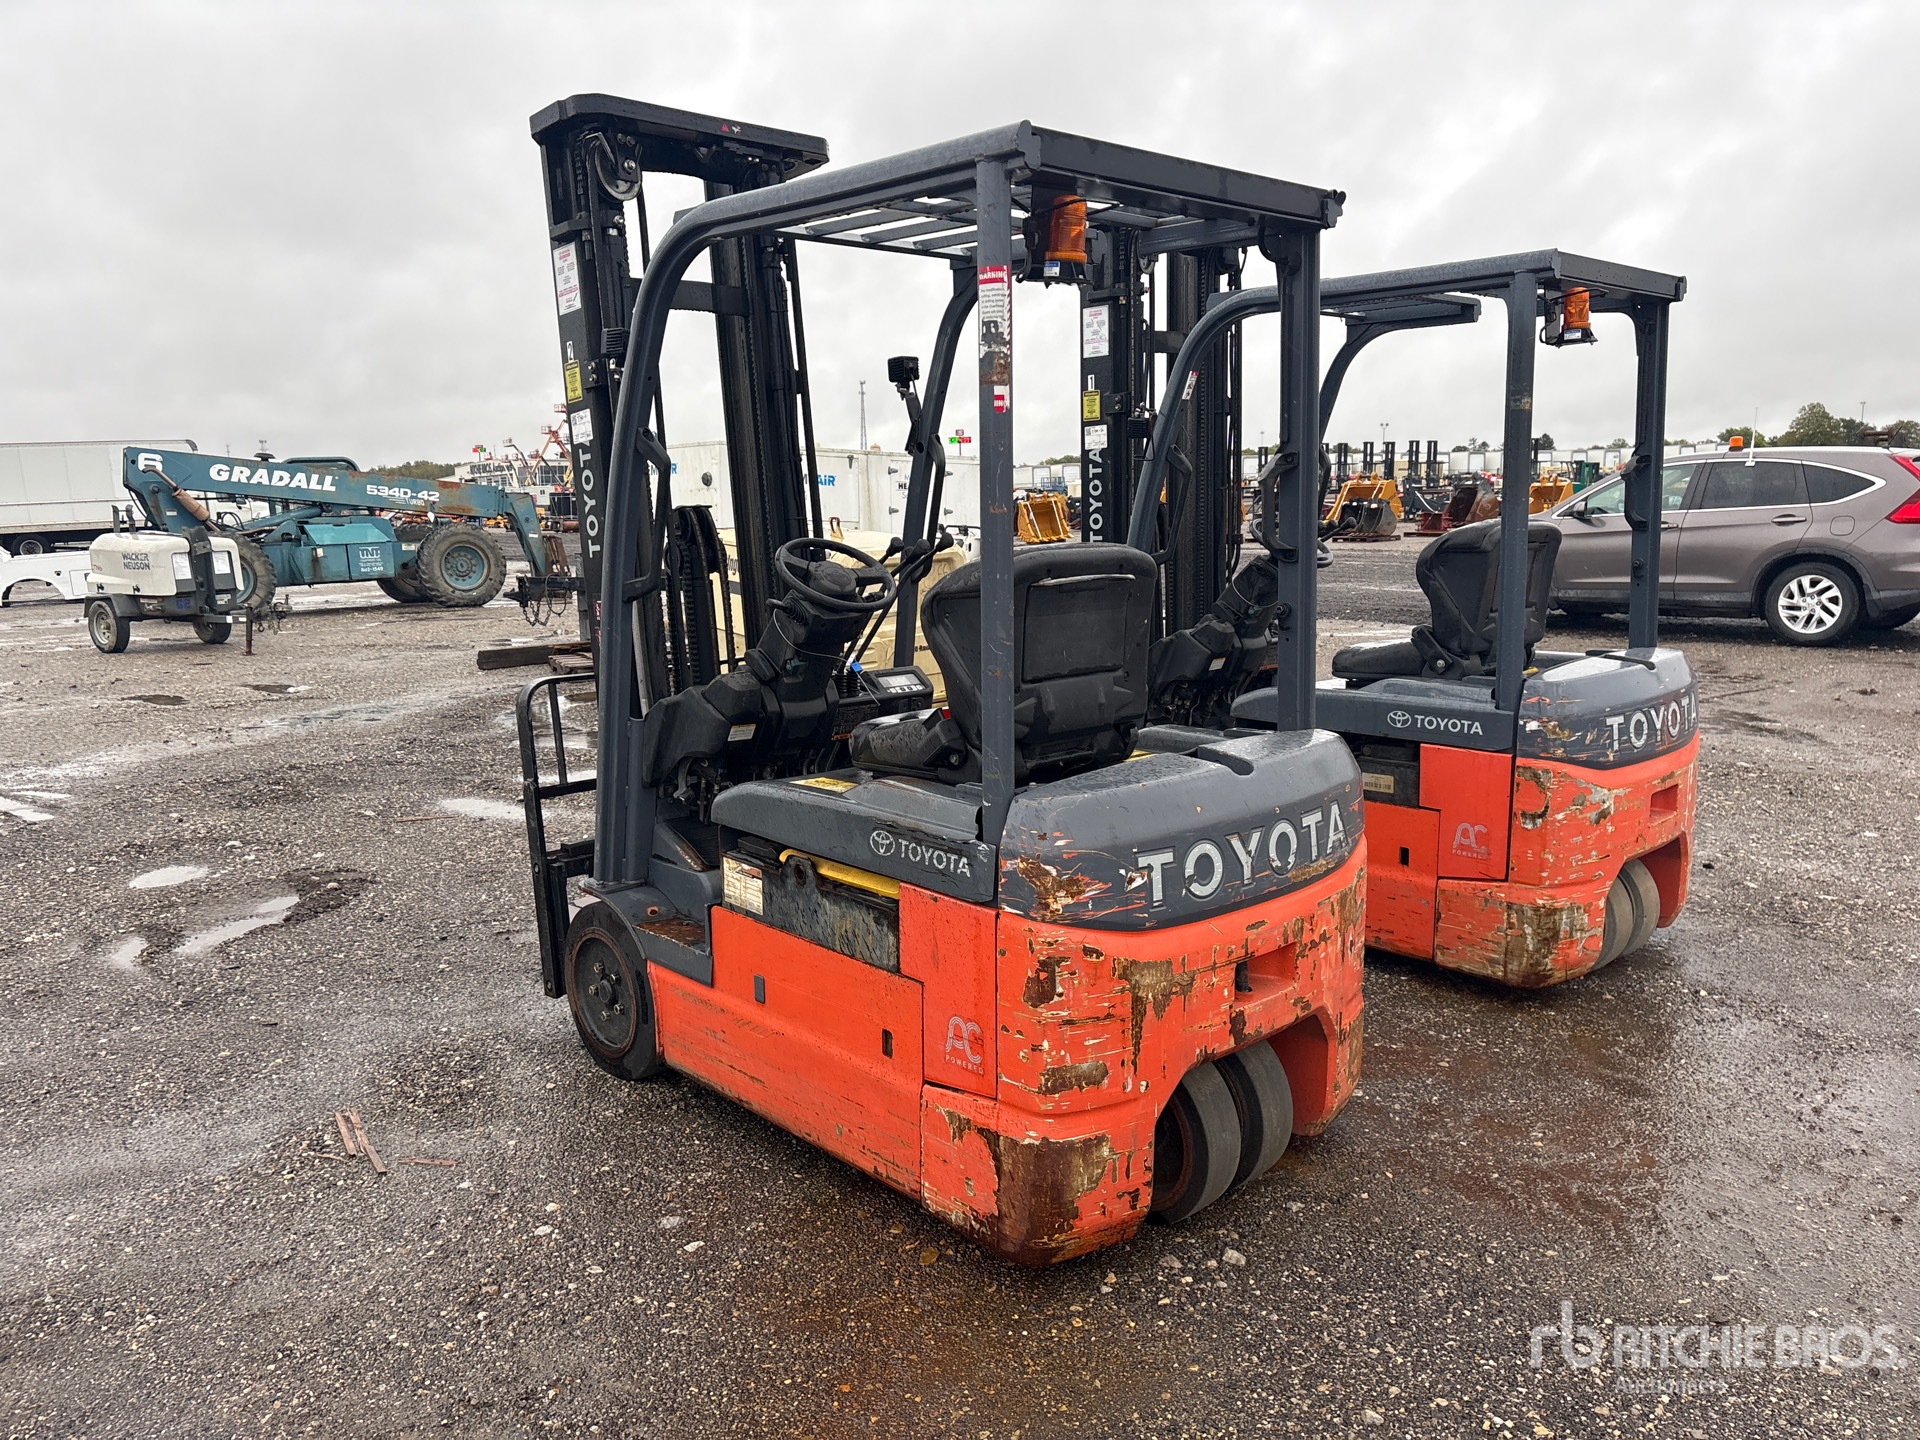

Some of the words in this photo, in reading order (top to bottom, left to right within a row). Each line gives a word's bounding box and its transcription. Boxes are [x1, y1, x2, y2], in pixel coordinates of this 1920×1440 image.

[1089, 376, 1094, 389] 1
[137, 453, 163, 473] 6
[209, 463, 336, 492] GRADALL
[366, 484, 440, 501] 534D-42
[578, 440, 601, 558] TOYOT
[1088, 448, 1103, 543] TOYOTA
[121, 553, 149, 563] WACKER
[123, 562, 150, 571] NEUSON
[1414, 714, 1483, 736] TOYOTA
[1605, 690, 1698, 751] TOYOTA
[898, 838, 971, 878] TOYOTA
[1136, 800, 1351, 907] TOYOTA
[945, 1054, 984, 1075] POWERED
